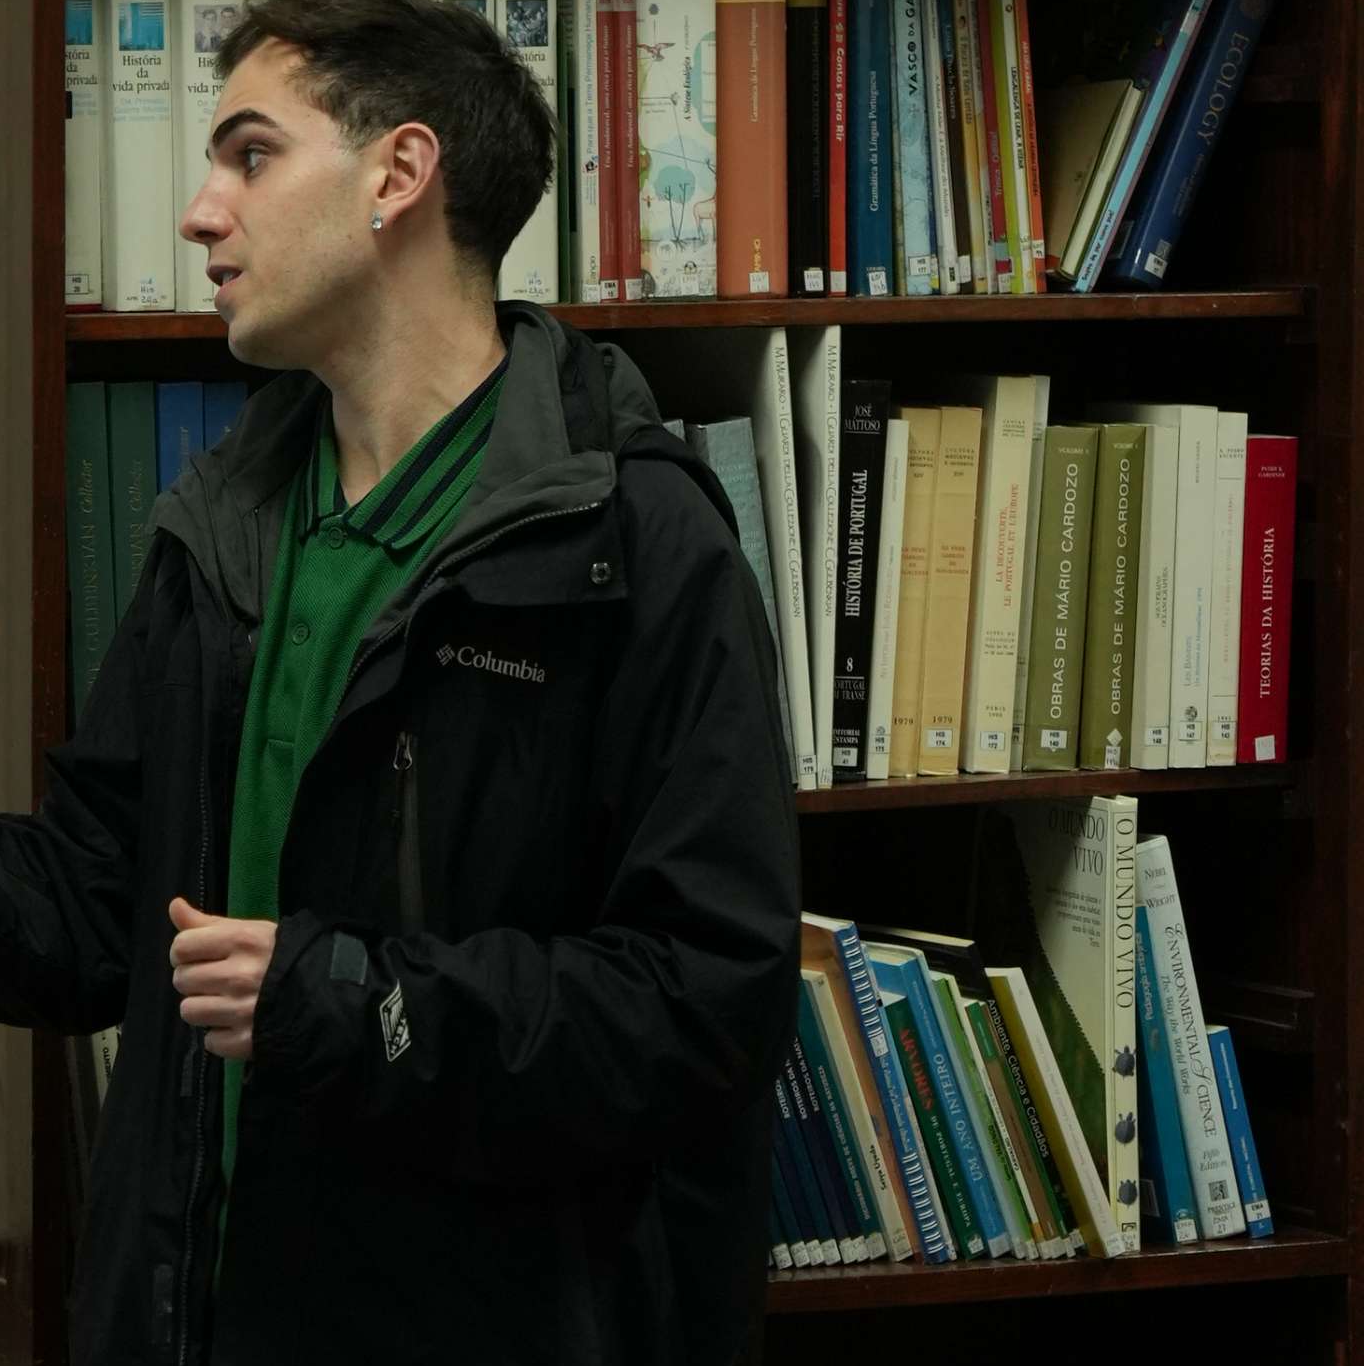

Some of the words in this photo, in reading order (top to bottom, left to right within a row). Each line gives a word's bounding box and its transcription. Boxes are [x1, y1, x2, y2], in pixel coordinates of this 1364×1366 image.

[908, 22, 916, 37] DA
[122, 55, 162, 67] História
[137, 67, 149, 78] da
[835, 47, 845, 88] Contos
[907, 41, 919, 96] VASCO
[112, 80, 134, 92] vida
[137, 80, 170, 94] privada
[187, 83, 209, 94] vida
[867, 70, 880, 119] Portuguesa
[1197, 31, 1250, 146] ECOLOGY
[834, 92, 844, 121] para
[835, 124, 845, 142] Rir
[868, 120, 880, 152] Língua
[868, 155, 879, 165] da
[868, 165, 879, 212] Gramática
[776, 360, 787, 404] MURARO
[827, 358, 837, 402] MURARO
[844, 418, 881, 432] MATTOSO
[854, 403, 873, 418] JOSÉ
[779, 418, 791, 455] GUARDI
[826, 417, 838, 454] GUARDI
[79, 459, 95, 514] Collector
[783, 458, 793, 488] DELLA
[826, 457, 836, 487] DELLA
[784, 488, 796, 546] COLLEZIONE
[825, 487, 837, 545] COLLEZIONE
[847, 468, 869, 538] PORTUGAL
[1061, 463, 1079, 553] CARDOZO
[1116, 458, 1131, 548] CARDOZO
[846, 539, 865, 556] DE
[1008, 529, 1017, 542] ET
[1004, 545, 1016, 592] PORTUGAL
[1259, 527, 1275, 601] HISTÓRIA
[789, 560, 802, 618] GULBENKIAN
[824, 559, 836, 617] GULBENKIAN
[842, 558, 865, 617] HISTÓRIA
[1054, 560, 1073, 620] MÁRIO
[1111, 555, 1127, 615] MÁRIO
[1260, 606, 1273, 627] DA
[1054, 627, 1068, 650] DE
[1112, 622, 1125, 646] DE
[456, 645, 547, 684] Columbia
[846, 657, 853, 673] 8
[1259, 632, 1273, 698] TEORIAS
[1050, 657, 1066, 719] OBRAS
[1111, 653, 1124, 715] OBRAS
[894, 716, 914, 725] 1979
[932, 715, 953, 724] 1979
[1059, 810, 1105, 842] MUNDO
[1115, 818, 1135, 836] O
[1073, 845, 1104, 876] VIVO
[1115, 845, 1135, 941] MUNDO
[1116, 948, 1135, 1009] VIVO
[1161, 974, 1172, 995] The
[1163, 996, 1176, 1016] Way
[987, 998, 1014, 1053] Ambiente,
[1169, 1018, 1180, 1035] the
[799, 1059, 810, 1073] DA
[1173, 1037, 1186, 1065] World
[787, 1066, 799, 1081] DA
[931, 1052, 962, 1116] INTEIRO
[1007, 1055, 1028, 1096] Ciência
[1178, 1067, 1192, 1096] Works
[1022, 1097, 1030, 1105] e
[954, 1118, 974, 1150] ANO
[1025, 1106, 1050, 1158] Cidadãos
[966, 1156, 984, 1182] UM
